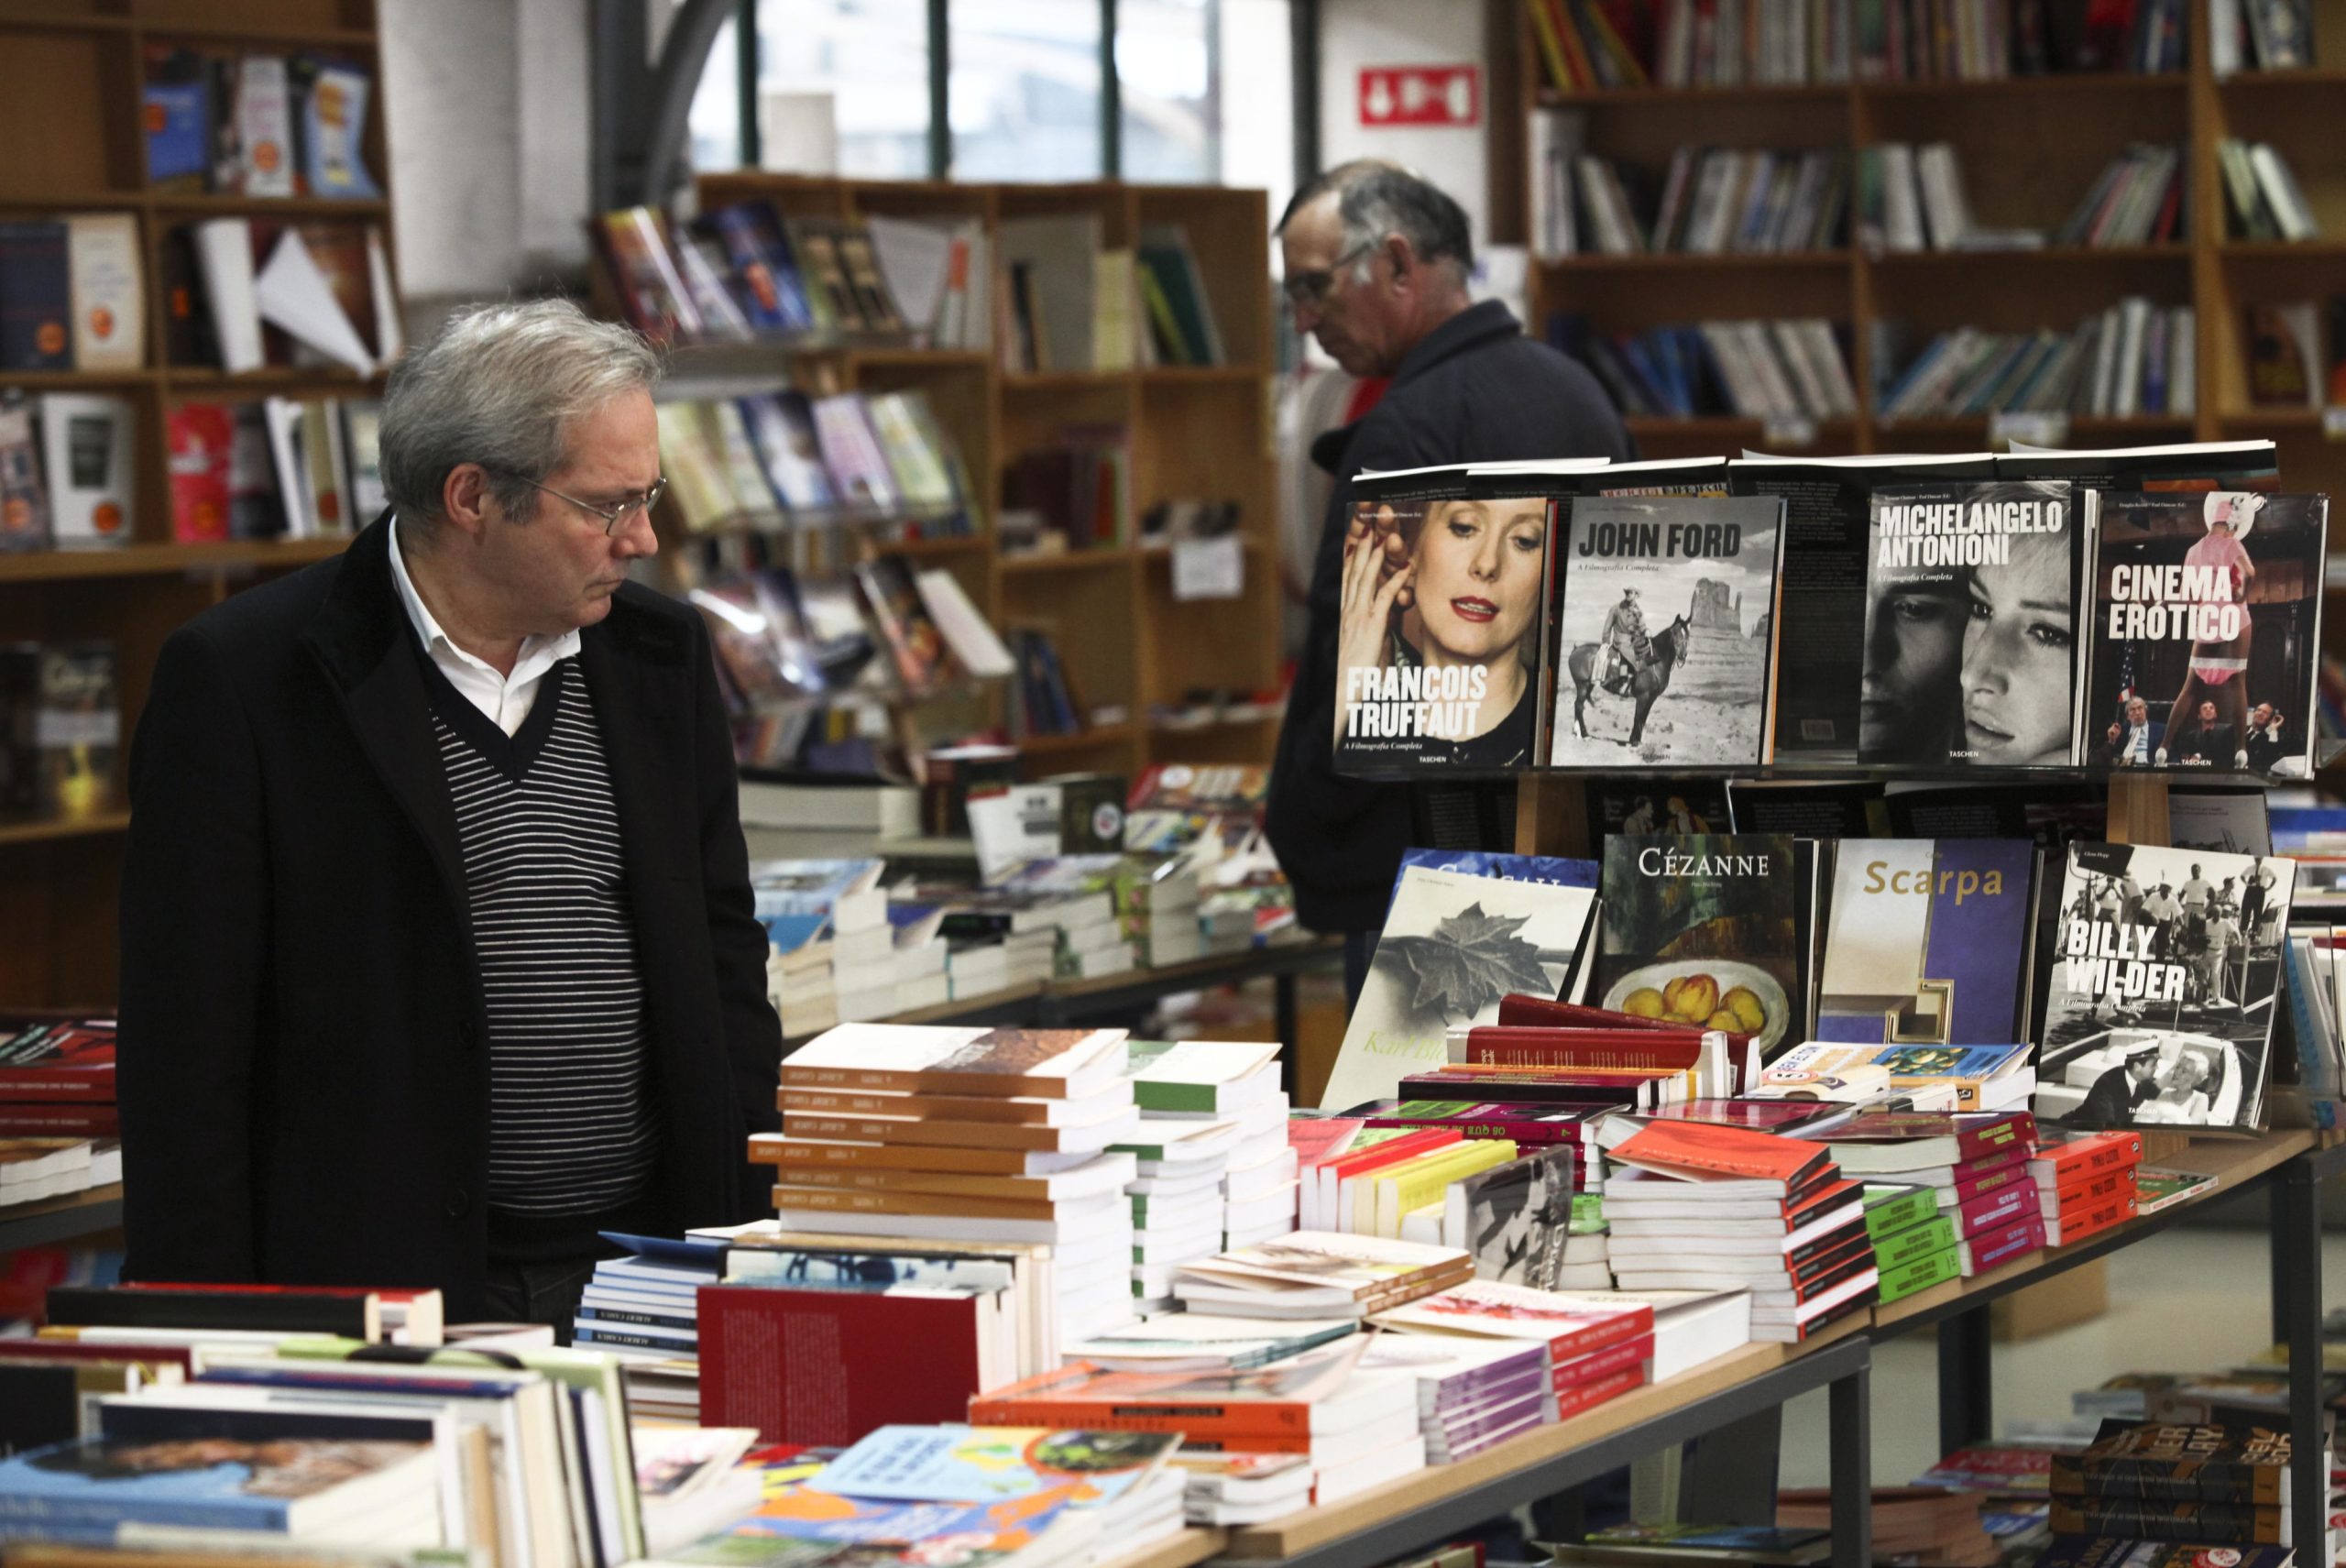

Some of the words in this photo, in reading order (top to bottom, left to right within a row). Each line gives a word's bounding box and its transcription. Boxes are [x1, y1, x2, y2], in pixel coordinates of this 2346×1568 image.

[1879, 500, 2063, 536] MICHELANGELO
[1578, 522, 1661, 557] JOHN
[1666, 523, 1741, 557] FORD
[1877, 533, 2010, 567] ANTONIONI
[1584, 564, 1624, 573] Filmografia
[1625, 564, 1660, 572] Completa
[1883, 575, 1920, 583] Filmografia
[1921, 573, 1953, 583] Completa
[2110, 564, 2232, 602] CINEMA
[2109, 600, 2241, 641] ERÓTICO
[1345, 664, 1487, 705] FRANÇOIS
[1345, 701, 1481, 738] TRUFFAUT
[1351, 741, 1389, 751] Filmografia
[1390, 741, 1423, 751] Completa
[1638, 847, 1769, 877] CÉZANNE
[1863, 861, 2002, 905] Scarpa
[2066, 919, 2157, 961] BILLY
[2066, 955, 2187, 1002] WILDER
[2058, 997, 2065, 1005] A
[2066, 998, 2110, 1010] Filmografia
[2110, 1002, 2147, 1014] Completa
[2128, 1106, 2157, 1114] TASCHEN
